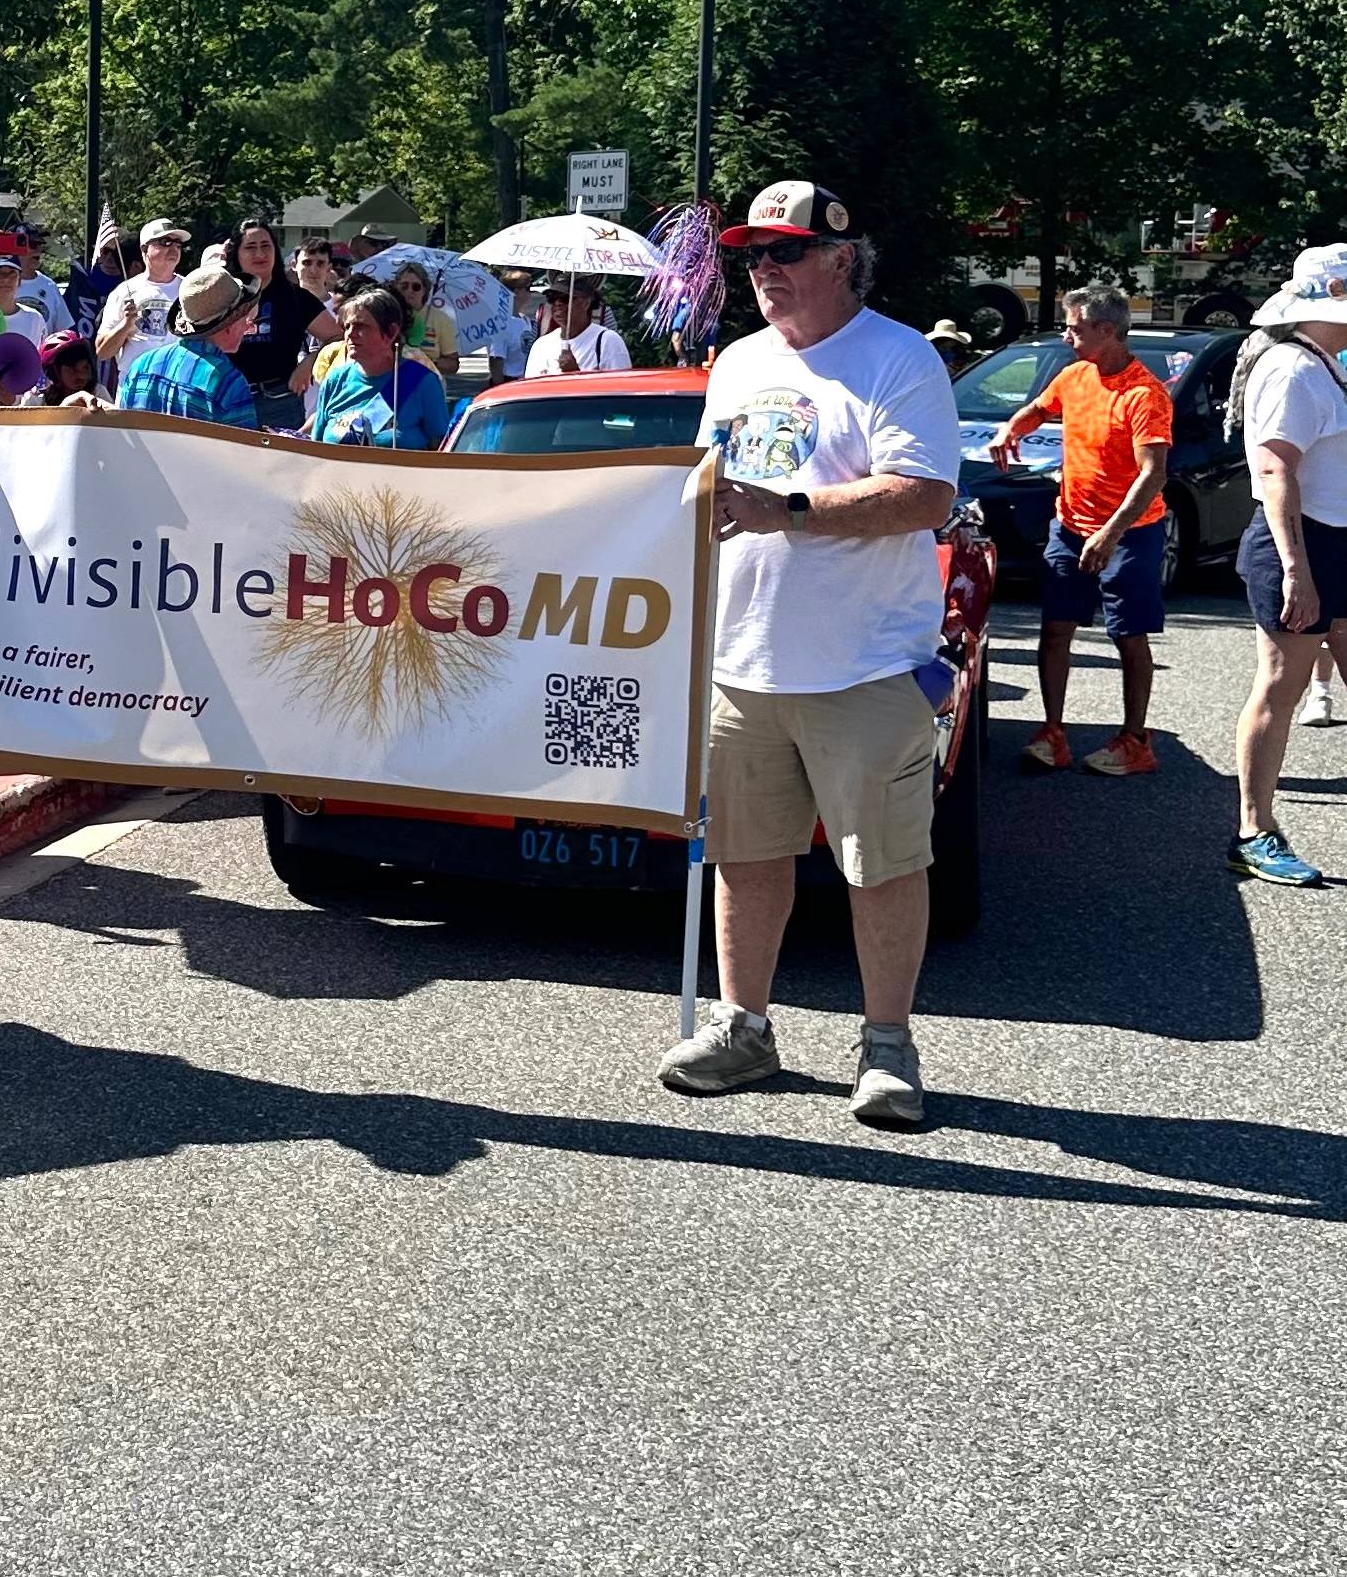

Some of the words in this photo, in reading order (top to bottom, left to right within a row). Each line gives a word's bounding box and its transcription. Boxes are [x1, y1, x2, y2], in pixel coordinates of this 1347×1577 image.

[573, 159, 598, 170] RIGHT
[602, 158, 624, 169] LANE
[582, 175, 613, 188] MUST
[598, 194, 623, 203] RIGHT
[508, 243, 574, 261] JUSTICE
[585, 248, 616, 264] FOR
[618, 252, 652, 268] ALL
[2, 643, 19, 662] a
[24, 642, 95, 674] fairer,
[68, 685, 209, 718] democracy
[589, 834, 640, 868] 517
